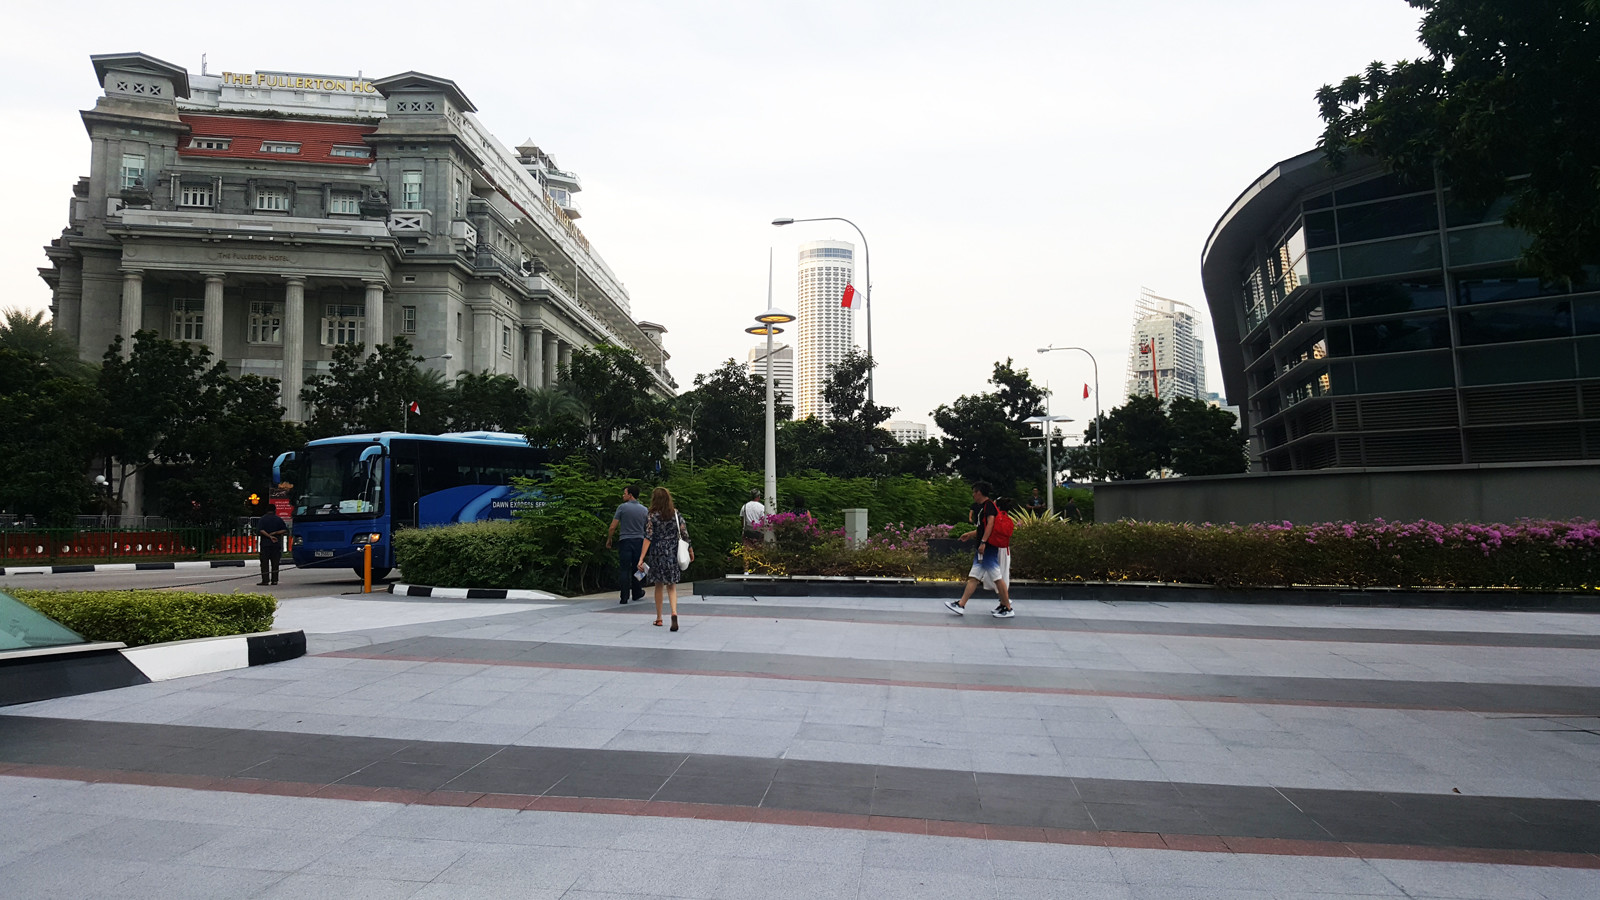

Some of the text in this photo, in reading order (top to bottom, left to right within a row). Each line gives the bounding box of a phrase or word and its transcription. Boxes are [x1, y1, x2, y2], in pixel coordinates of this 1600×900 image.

[222, 71, 253, 85] THE
[257, 73, 347, 91] FULLERTON
[233, 253, 267, 261] FULLERTON
[492, 501, 509, 509] DAWN
